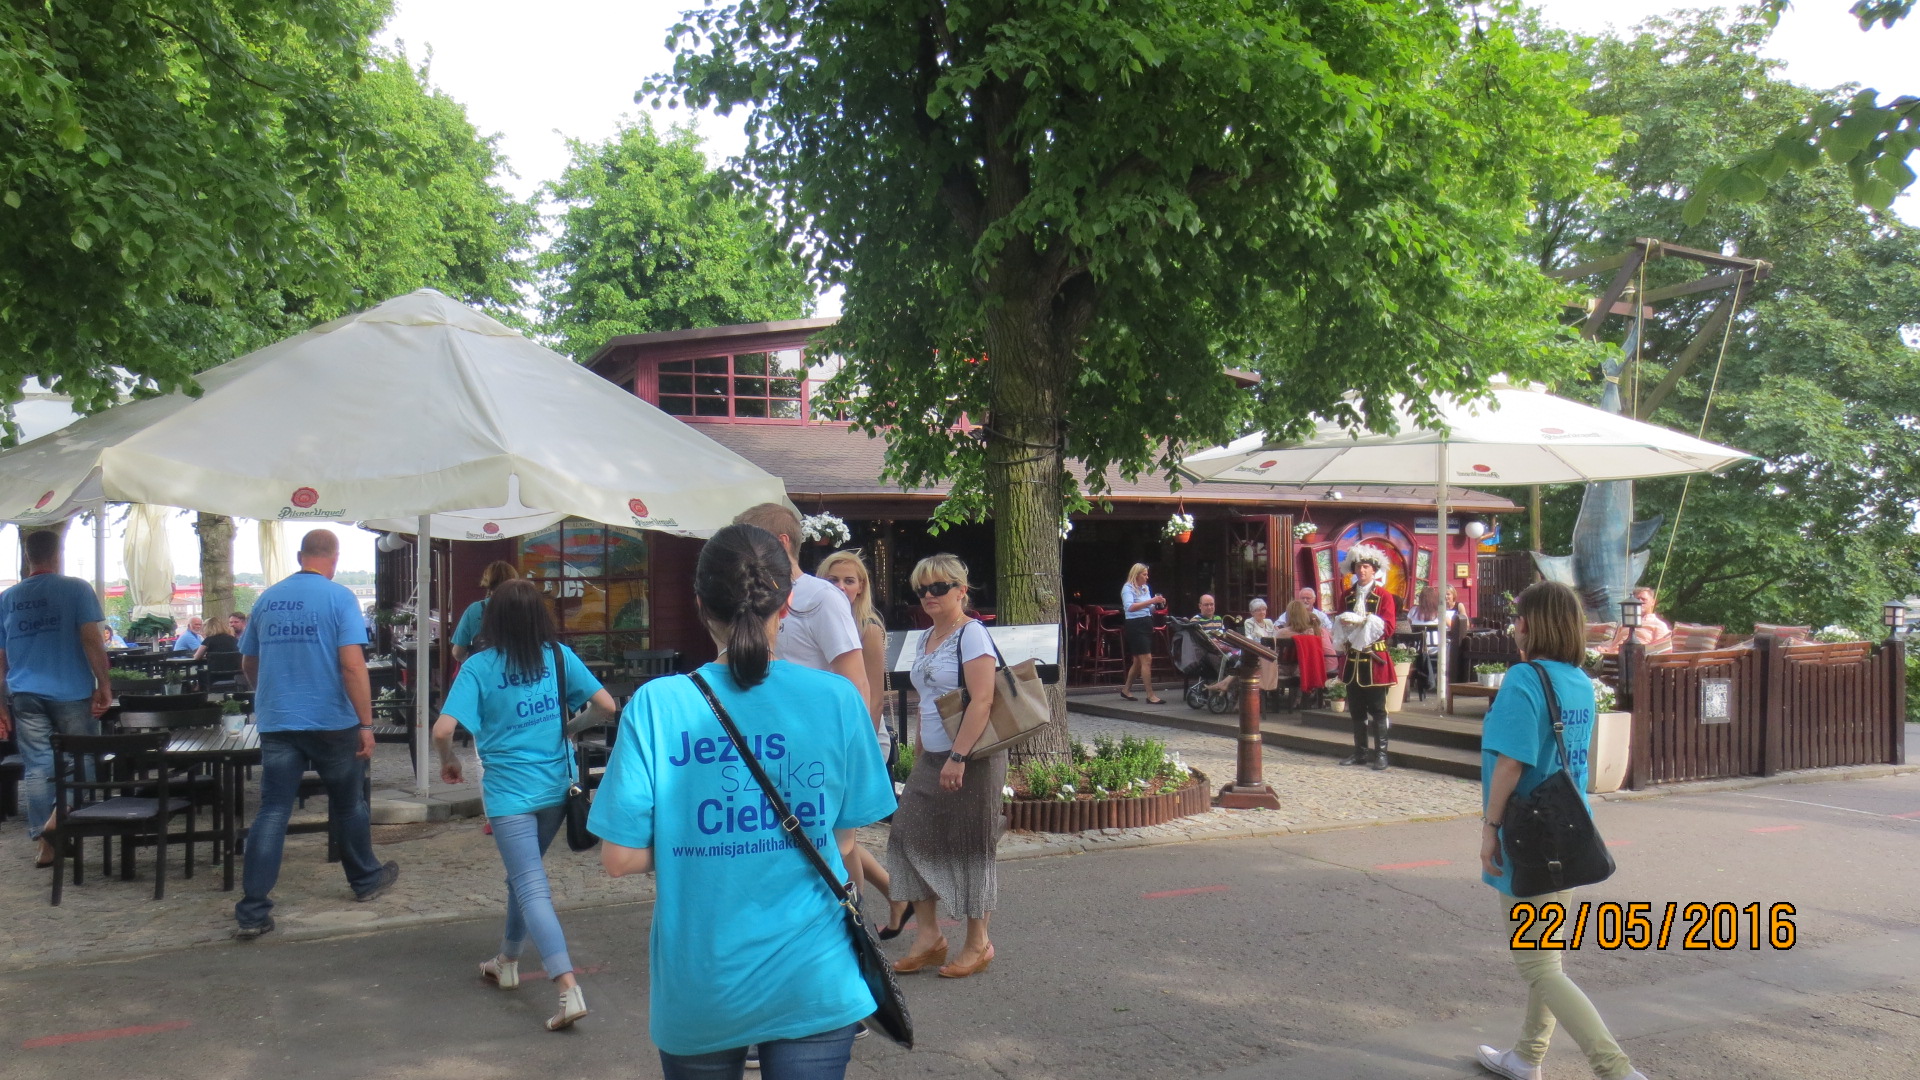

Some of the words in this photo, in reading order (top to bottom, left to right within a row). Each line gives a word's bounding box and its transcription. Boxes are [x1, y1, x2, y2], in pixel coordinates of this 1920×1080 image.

[278, 506, 314, 519] Pilsner
[313, 508, 346, 518] Urquell
[10, 598, 48, 613] Jezus
[263, 600, 305, 613] Jezus
[268, 622, 318, 637] Ciebie!
[498, 666, 551, 690] Jezus
[524, 679, 555, 698] szu
[516, 694, 561, 718] Ciebi
[1561, 708, 1590, 726] ezus
[669, 731, 786, 767] Jezus
[721, 752, 825, 793] szuka
[673, 833, 827, 858] www.misjatalithaku.pl
